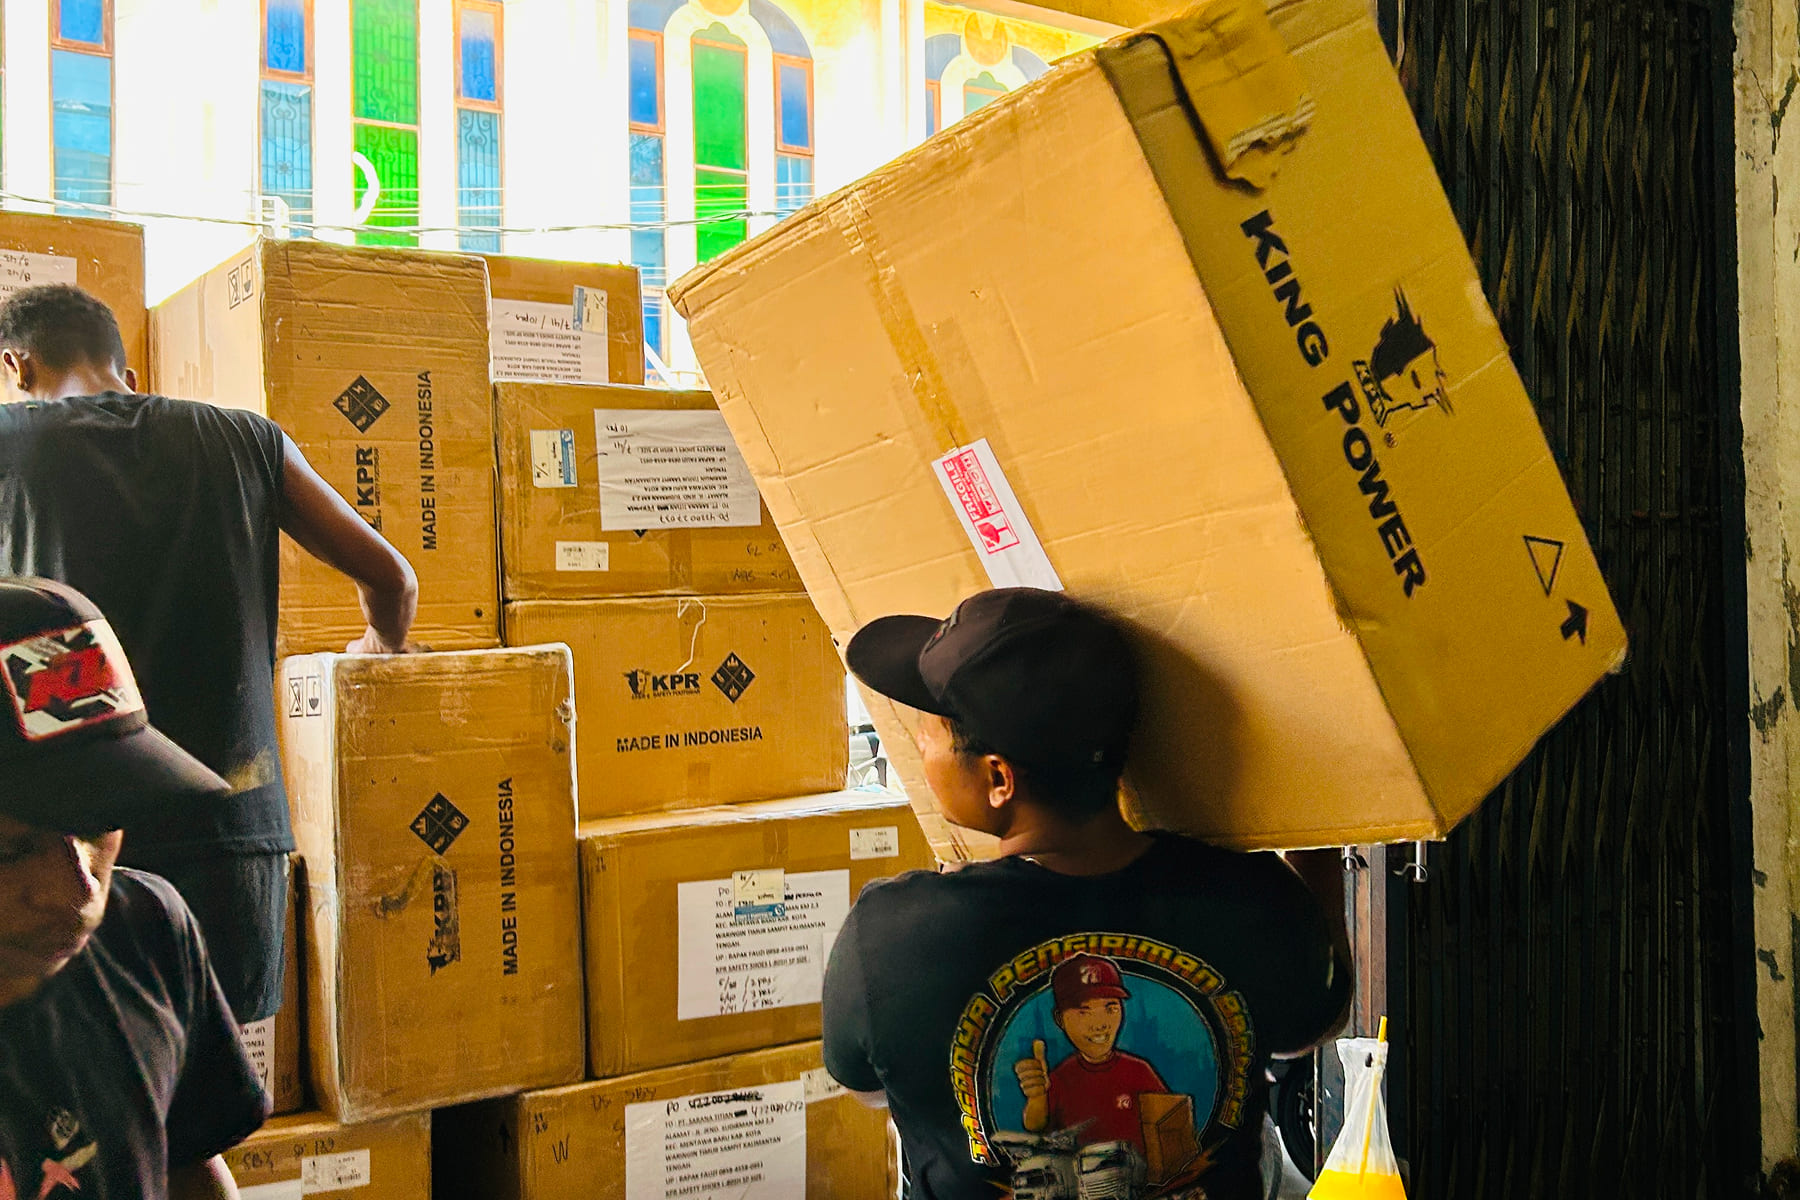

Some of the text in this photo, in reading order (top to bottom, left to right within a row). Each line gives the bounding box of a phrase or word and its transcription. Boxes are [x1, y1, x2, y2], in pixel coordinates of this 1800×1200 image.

[1240, 209, 1427, 599] KING POWER
[357, 447, 374, 506] KPR
[418, 370, 436, 550] MADE IN INDONESIA
[946, 461, 981, 519] FRAGILE
[652, 673, 700, 691] KPR
[617, 726, 763, 752] MADE IN INDONESIA
[498, 778, 518, 976] MADE IN INDONESIA
[989, 933, 1225, 1003] PENGIRIMAN
[664, 1131, 689, 1139] ALAMAT
[679, 1138, 711, 1148] MENTAWA
[742, 1136, 781, 1147] KALIMANTAN
